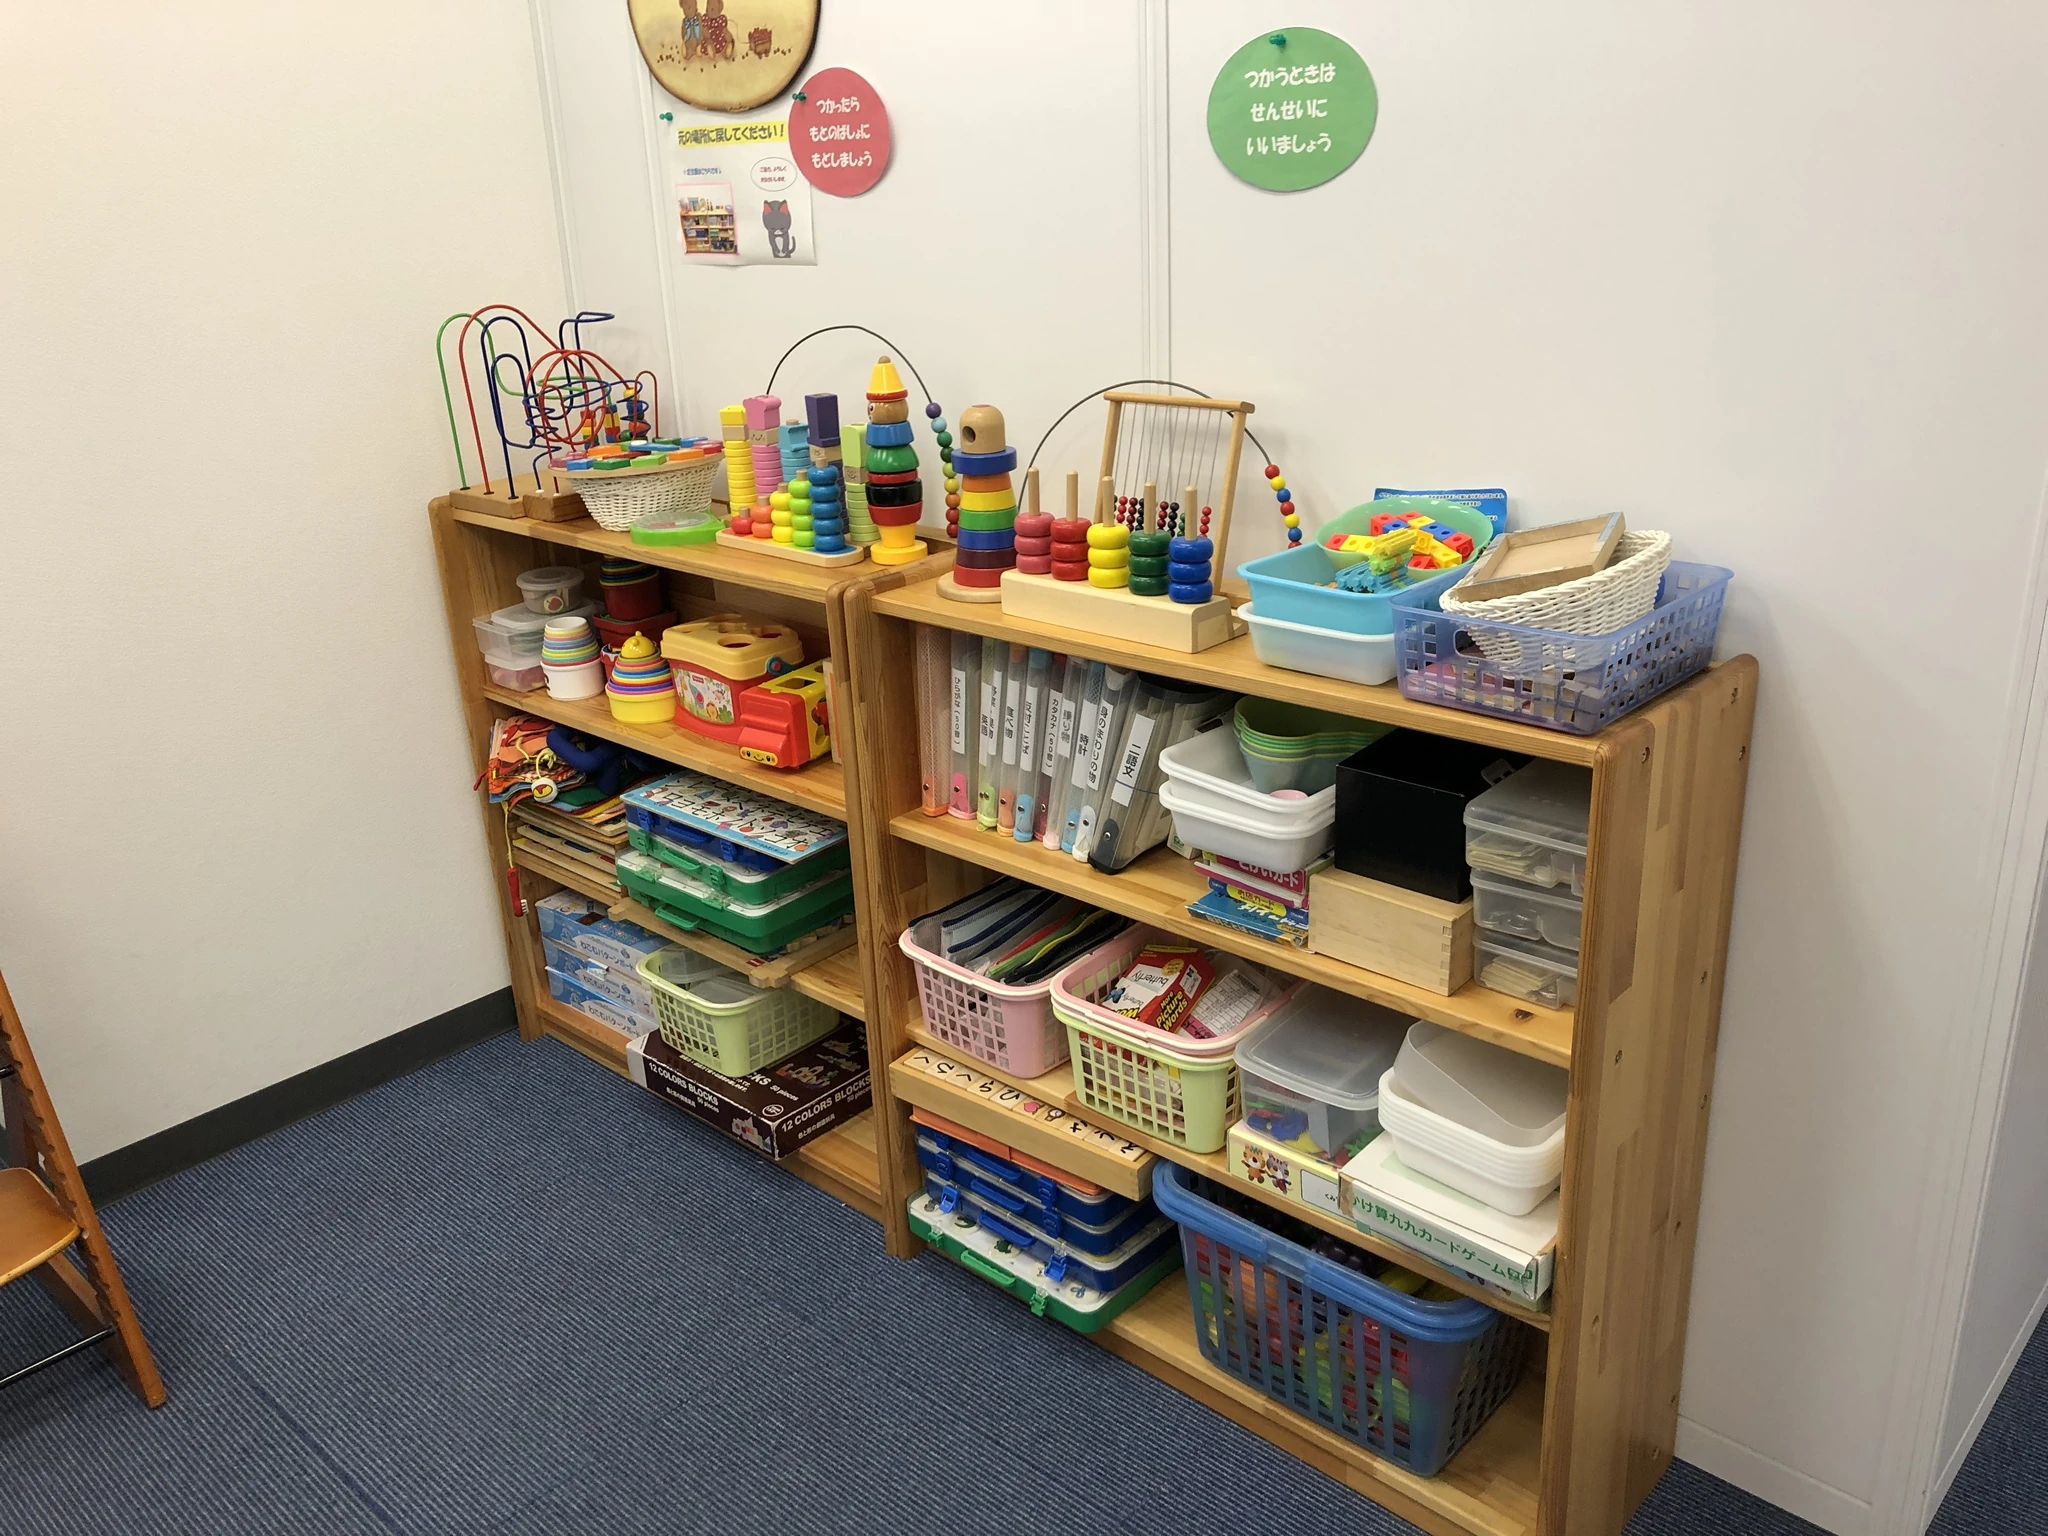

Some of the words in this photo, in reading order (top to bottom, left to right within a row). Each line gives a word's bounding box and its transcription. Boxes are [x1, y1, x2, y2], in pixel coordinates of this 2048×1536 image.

[1244, 62, 1336, 88] つかうときは
[816, 96, 860, 115] つかったら
[1250, 98, 1328, 123] せんせいに
[678, 124, 784, 145] 元の場所に戻してください！
[809, 123, 871, 142] もとのばしょに
[1246, 132, 1332, 156] いいましょう
[811, 151, 873, 169] もどしましょう
[1078, 733, 1090, 757] 時計
[1088, 706, 1109, 784] 身のまわりの物
[1122, 743, 1142, 779] 二語文
[1132, 969, 1170, 988] butterfly
[1156, 990, 1183, 1028] Picture
[1160, 991, 1175, 1009] More
[1163, 999, 1188, 1032] Words
[648, 1062, 659, 1074] 12
[657, 1065, 687, 1089] COLORS
[688, 1083, 719, 1106] BLOCKS
[777, 1089, 799, 1101] pieces
[781, 1120, 794, 1133] 12
[794, 1097, 832, 1125] COLORS
[834, 1076, 871, 1102] BLOCKS
